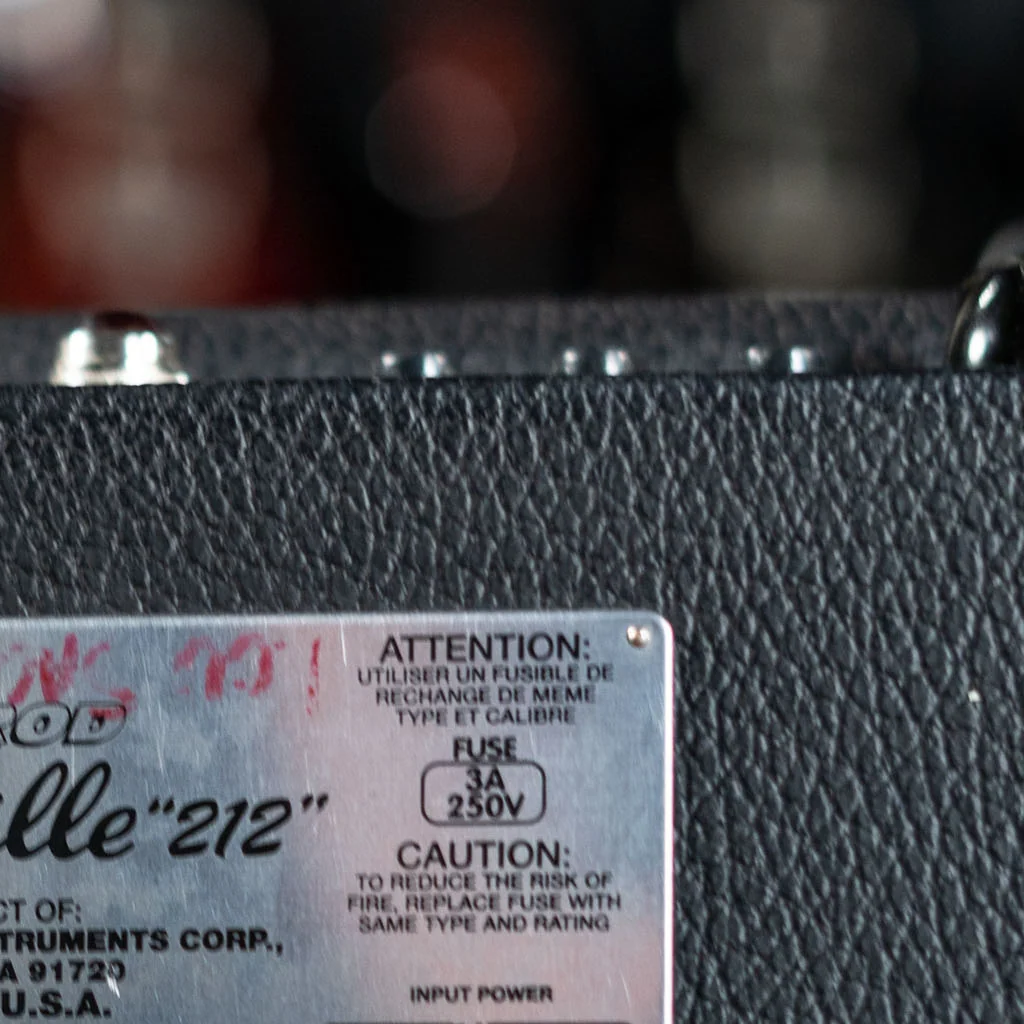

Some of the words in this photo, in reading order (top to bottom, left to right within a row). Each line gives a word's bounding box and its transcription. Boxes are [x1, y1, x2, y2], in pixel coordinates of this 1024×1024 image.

[378, 632, 591, 664] ATTENTION:
[357, 666, 450, 686] UTILISER
[456, 665, 486, 684] UN
[492, 664, 580, 683] FUSIBLE
[586, 663, 614, 682] DE
[375, 686, 492, 706] RECHANGE
[498, 685, 525, 703] DE
[532, 684, 597, 703] MEME
[396, 707, 448, 727] TYPE
[454, 707, 477, 725] ET
[485, 706, 577, 725] CALIBRE
[452, 736, 518, 761] FUSE
[465, 766, 507, 792] 3A
[447, 793, 526, 819] 250V
[396, 840, 571, 870] CAUTION:
[355, 872, 384, 892] TO
[390, 873, 477, 891] REDUCE
[483, 873, 523, 891] THE
[529, 872, 578, 891] RISK
[584, 871, 613, 889] OF
[34, 899, 81, 923] OF:
[347, 894, 399, 915] FIRE,
[405, 894, 501, 914] REPLACE
[507, 893, 562, 912] FUSE
[569, 892, 622, 911] WITH
[358, 915, 418, 935] SAME
[425, 915, 477, 934] TYPE
[483, 914, 527, 934] AND
[534, 913, 611, 933] RATING
[1, 987, 113, 1018] U.S.A.
[409, 985, 470, 1004] INPUT
[477, 984, 553, 1003] POWER
